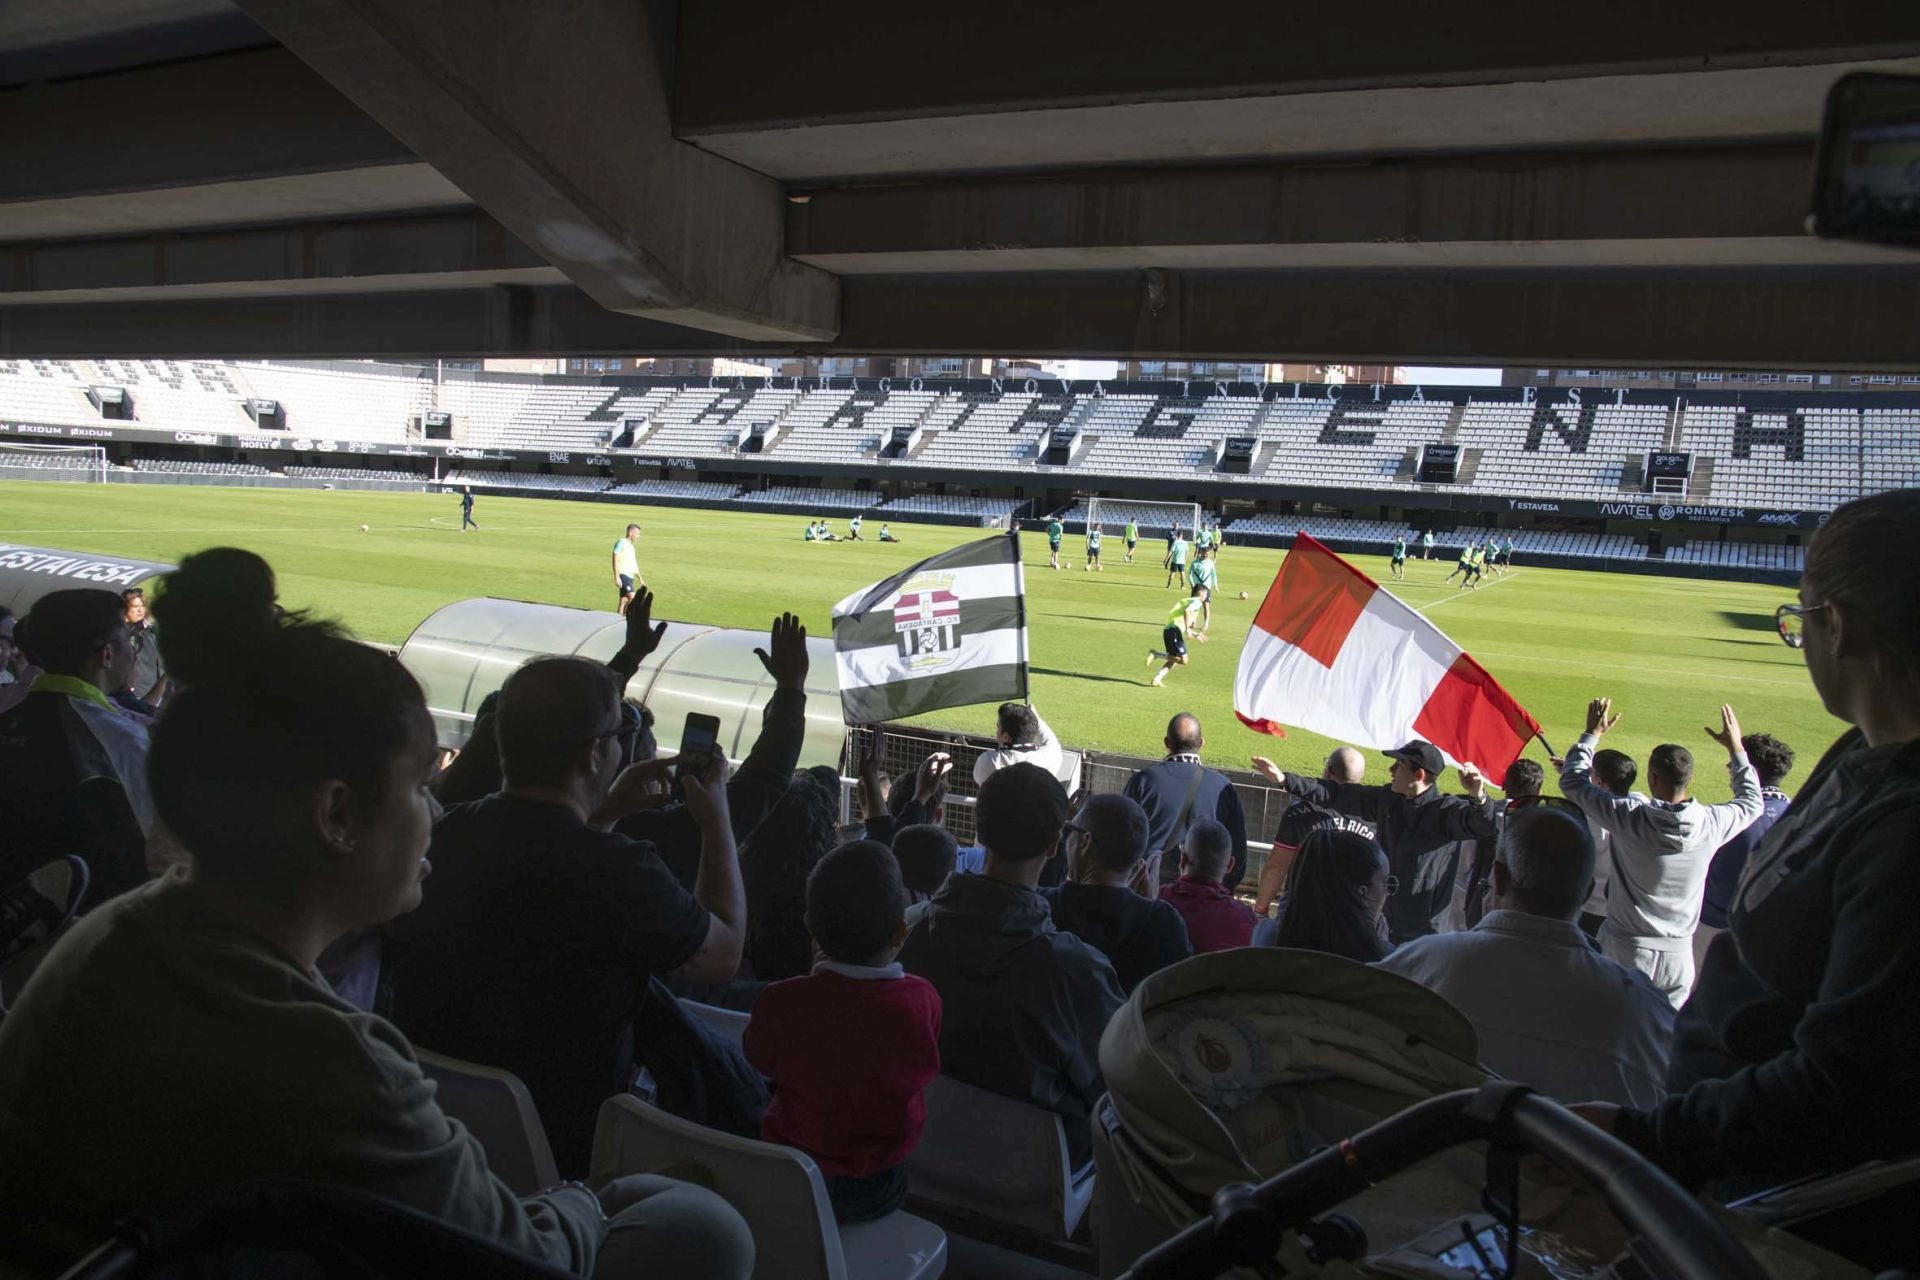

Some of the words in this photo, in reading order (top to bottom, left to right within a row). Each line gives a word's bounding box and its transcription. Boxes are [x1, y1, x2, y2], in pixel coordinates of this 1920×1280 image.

[708, 376, 924, 393] CARTHAGO
[990, 378, 1106, 396] NOVA
[1183, 381, 1425, 405] INVICTA
[1522, 385, 1630, 405] EST
[1517, 502, 1560, 512] ESTAVESA
[1600, 503, 1654, 517] AVATEL
[1676, 506, 1746, 518] RONIWESK
[0, 551, 151, 585] ESTAVESA
